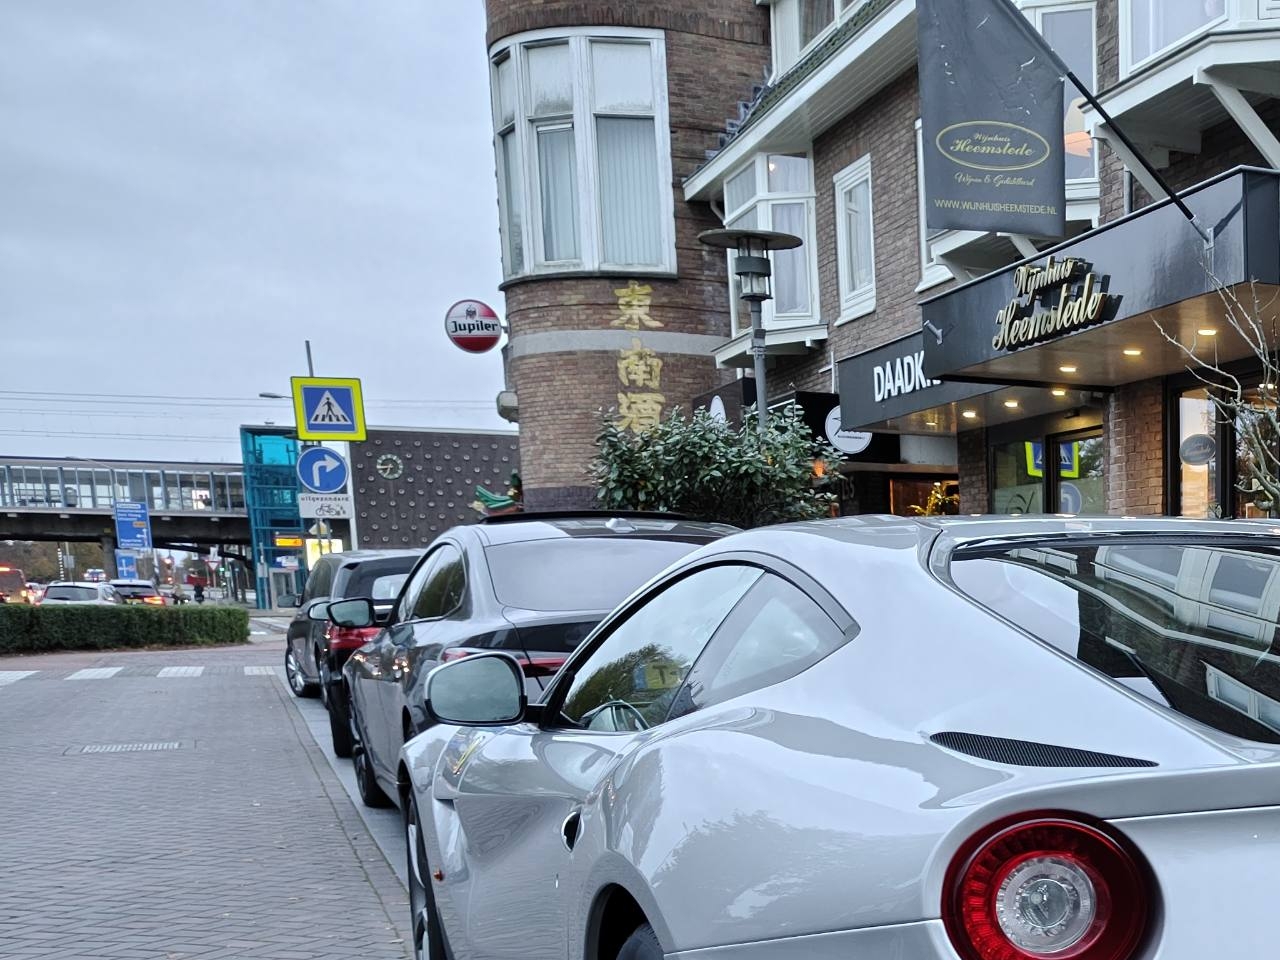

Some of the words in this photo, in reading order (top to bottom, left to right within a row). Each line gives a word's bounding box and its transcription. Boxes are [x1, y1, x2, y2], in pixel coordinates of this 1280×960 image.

[950, 138, 1035, 156] Heemstede
[934, 199, 1057, 215] WWW.WIJNHUISHEEMSTEDE.NL
[1013, 256, 1075, 305] Wijnhuis
[451, 320, 498, 334] Jupiler
[992, 272, 1107, 351] Heemstede
[873, 350, 942, 402] DAADK
